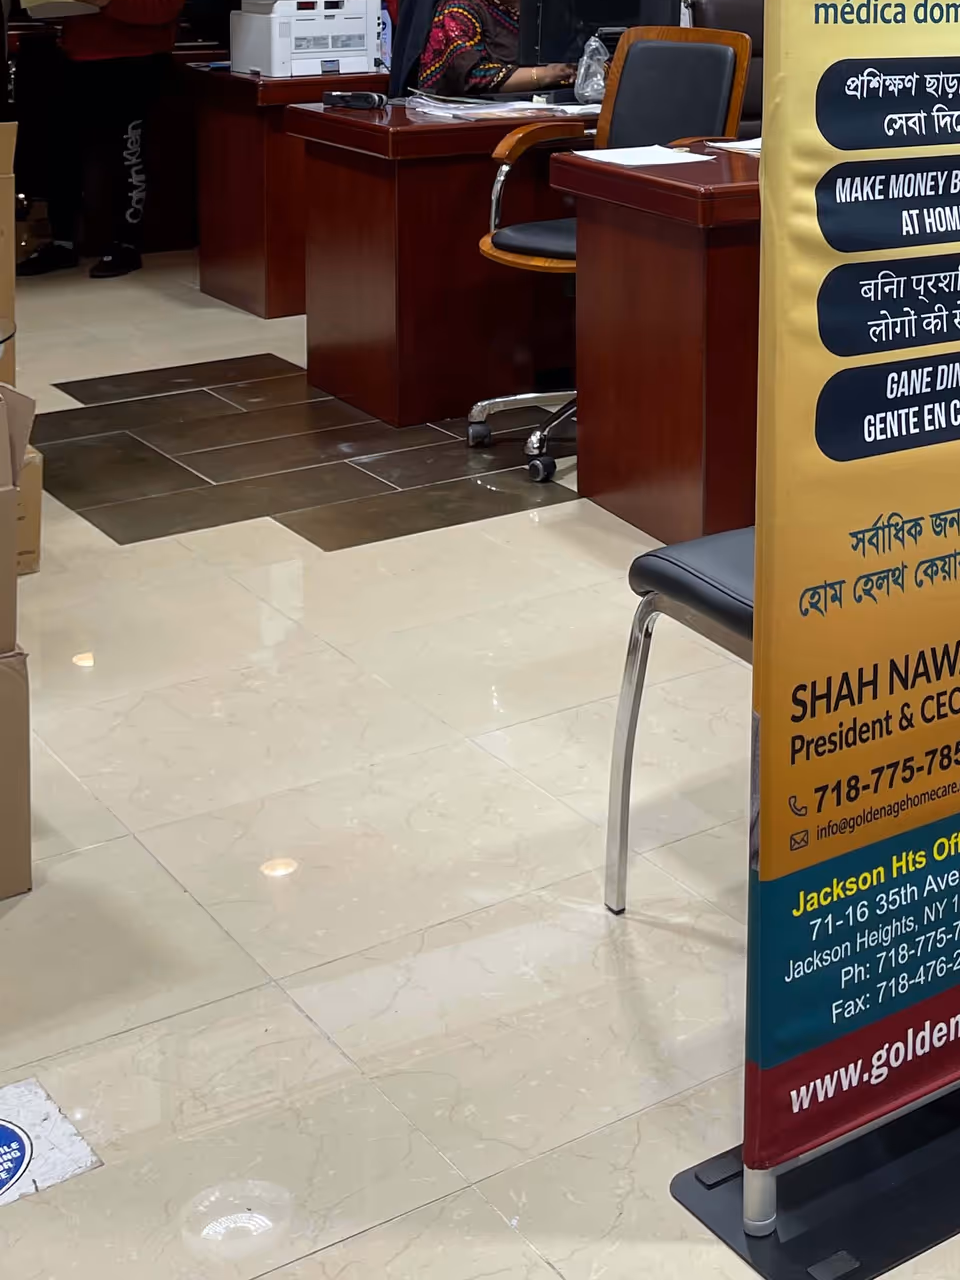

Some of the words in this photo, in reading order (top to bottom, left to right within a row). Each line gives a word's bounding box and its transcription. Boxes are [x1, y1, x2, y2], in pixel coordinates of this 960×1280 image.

[845, 68, 918, 100] প্রশিক্ষণ
[884, 111, 926, 136] সেবা
[835, 175, 884, 203] MAKE
[889, 170, 948, 198] MONEY
[902, 209, 920, 236] AT
[868, 308, 917, 342] लोगों
[921, 305, 948, 335] की
[886, 368, 932, 400] GANE
[864, 407, 920, 442] GENTE
[924, 401, 946, 432] EN
[849, 512, 925, 558] সর্বাধিক
[799, 579, 846, 617] হোম
[853, 561, 908, 604] হেলথ
[790, 663, 878, 723] SHAH
[790, 710, 892, 766] President
[899, 702, 915, 731] &
[792, 865, 886, 918] Jackson
[892, 846, 926, 879] Hts
[809, 904, 869, 941] 71-16
[876, 884, 918, 917] 35th
[784, 938, 852, 983] Jackson
[856, 915, 920, 953] Heights,
[924, 898, 947, 921] NY
[841, 962, 872, 988] Ph:
[831, 989, 872, 1023] Fax:
